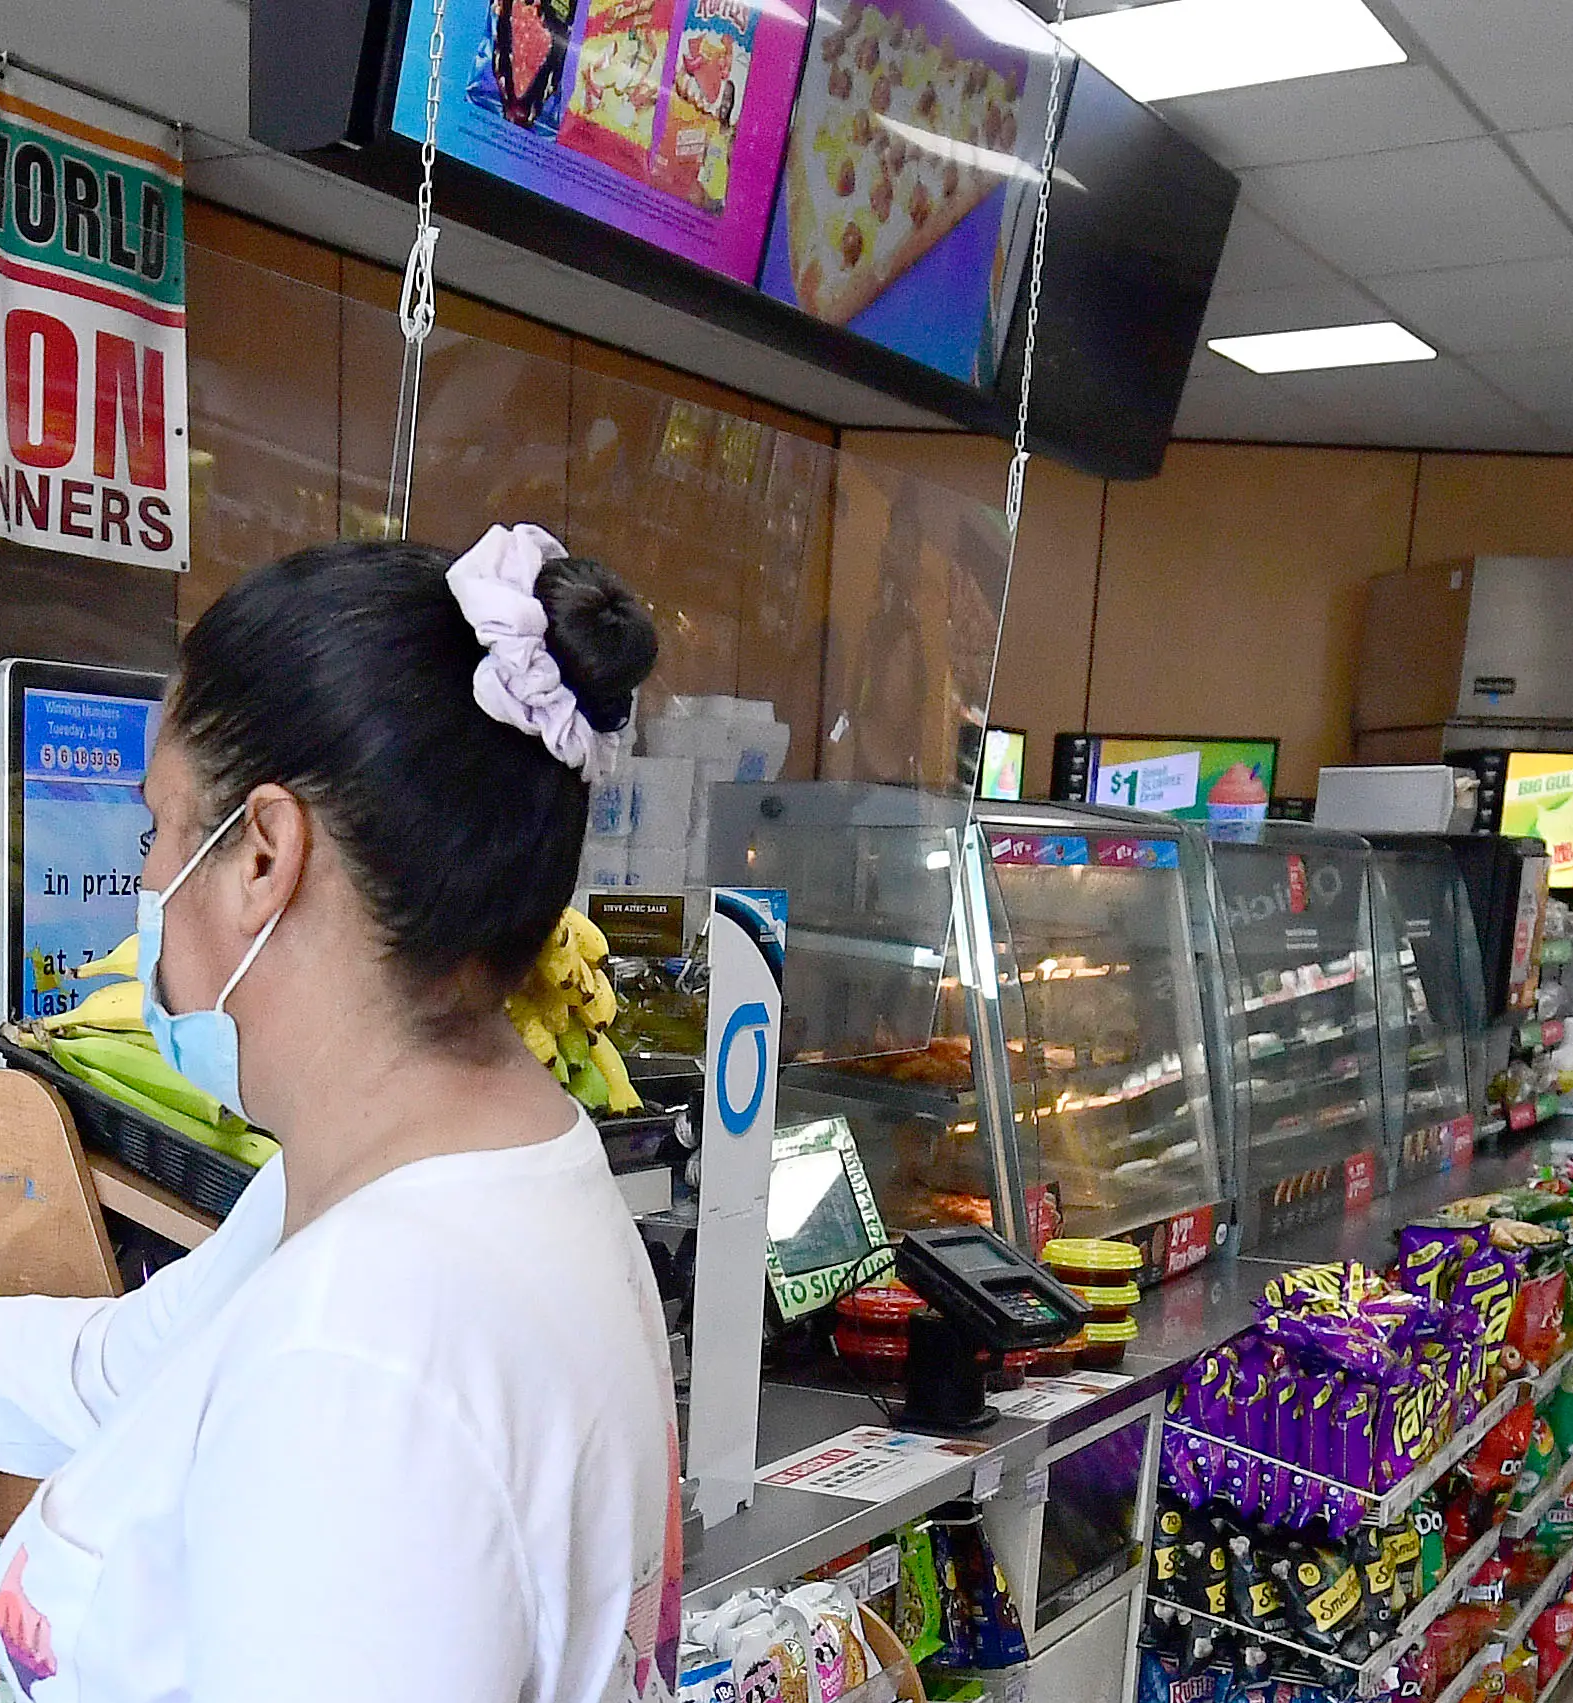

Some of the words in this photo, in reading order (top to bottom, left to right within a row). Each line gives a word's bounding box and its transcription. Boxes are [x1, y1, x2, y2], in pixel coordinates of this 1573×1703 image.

[44, 748, 52, 762] 5
[60, 749, 68, 763] 6
[74, 751, 88, 764] 18
[1517, 778, 1543, 797] BIG
[43, 868, 69, 896] in
[43, 949, 67, 976] at
[777, 1280, 808, 1309] TO
[809, 1262, 857, 1300] SIGN
